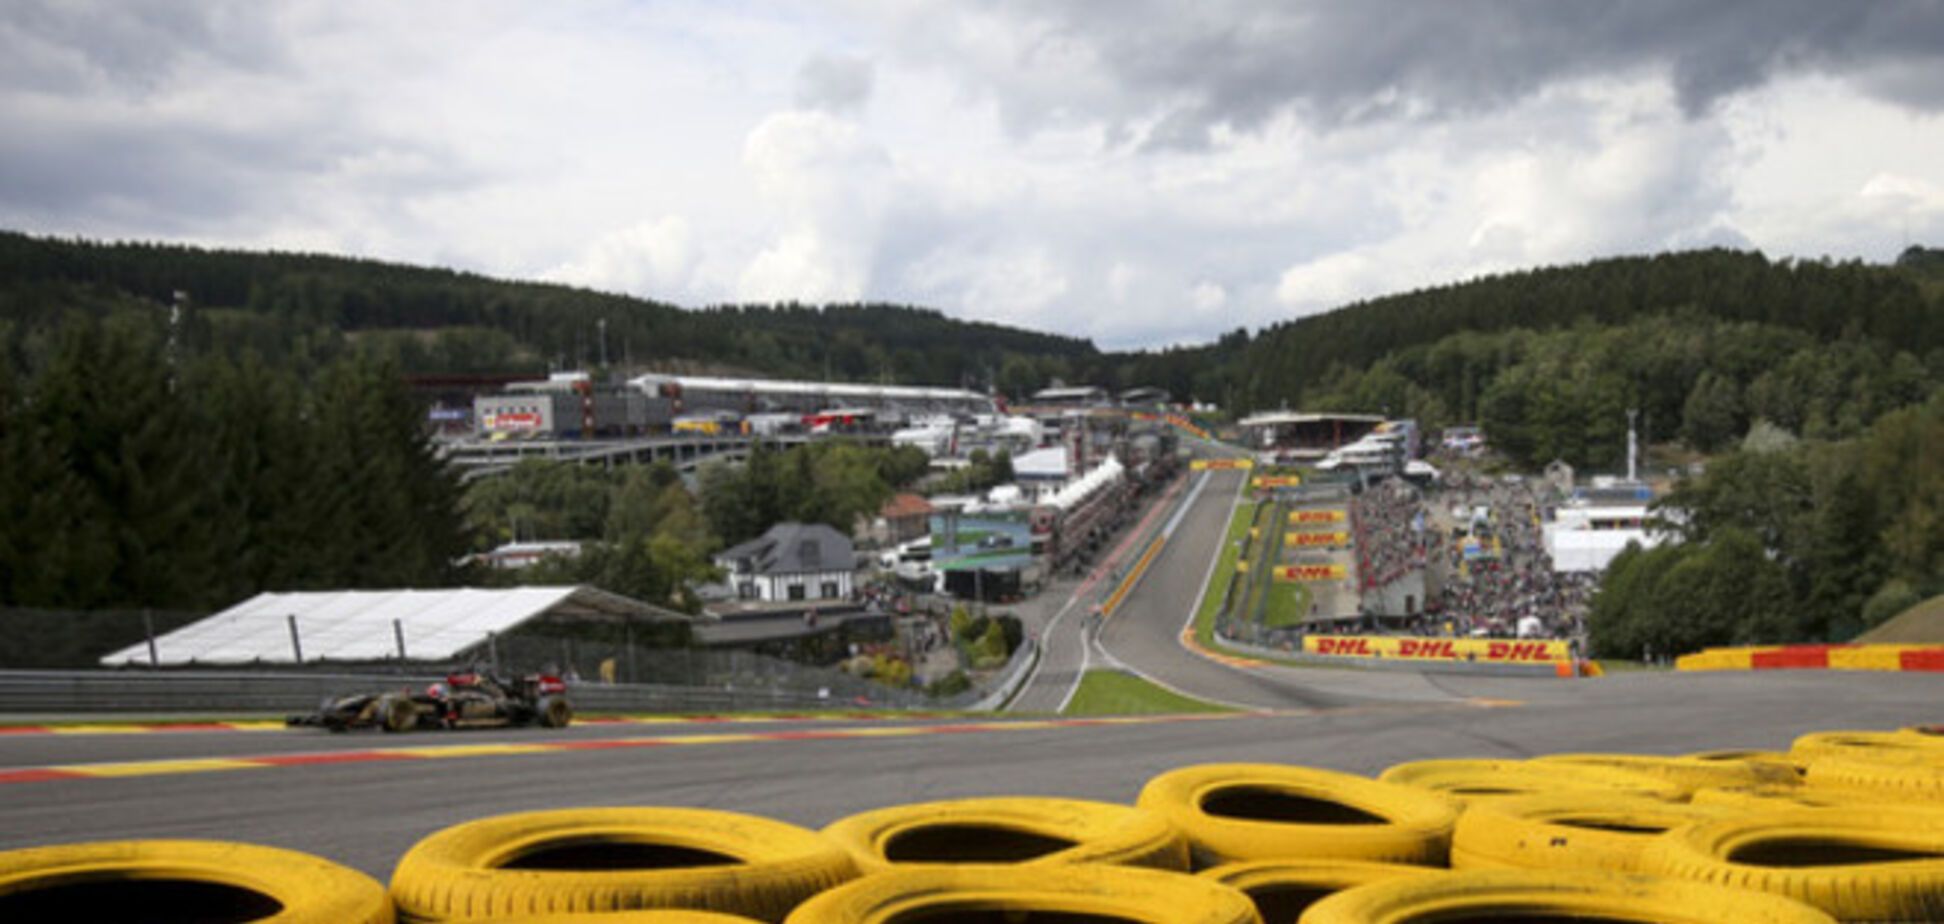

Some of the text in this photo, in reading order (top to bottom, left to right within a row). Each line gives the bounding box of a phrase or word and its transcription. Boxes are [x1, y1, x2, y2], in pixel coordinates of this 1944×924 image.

[1317, 637, 1552, 661] DHL DHL DHL
